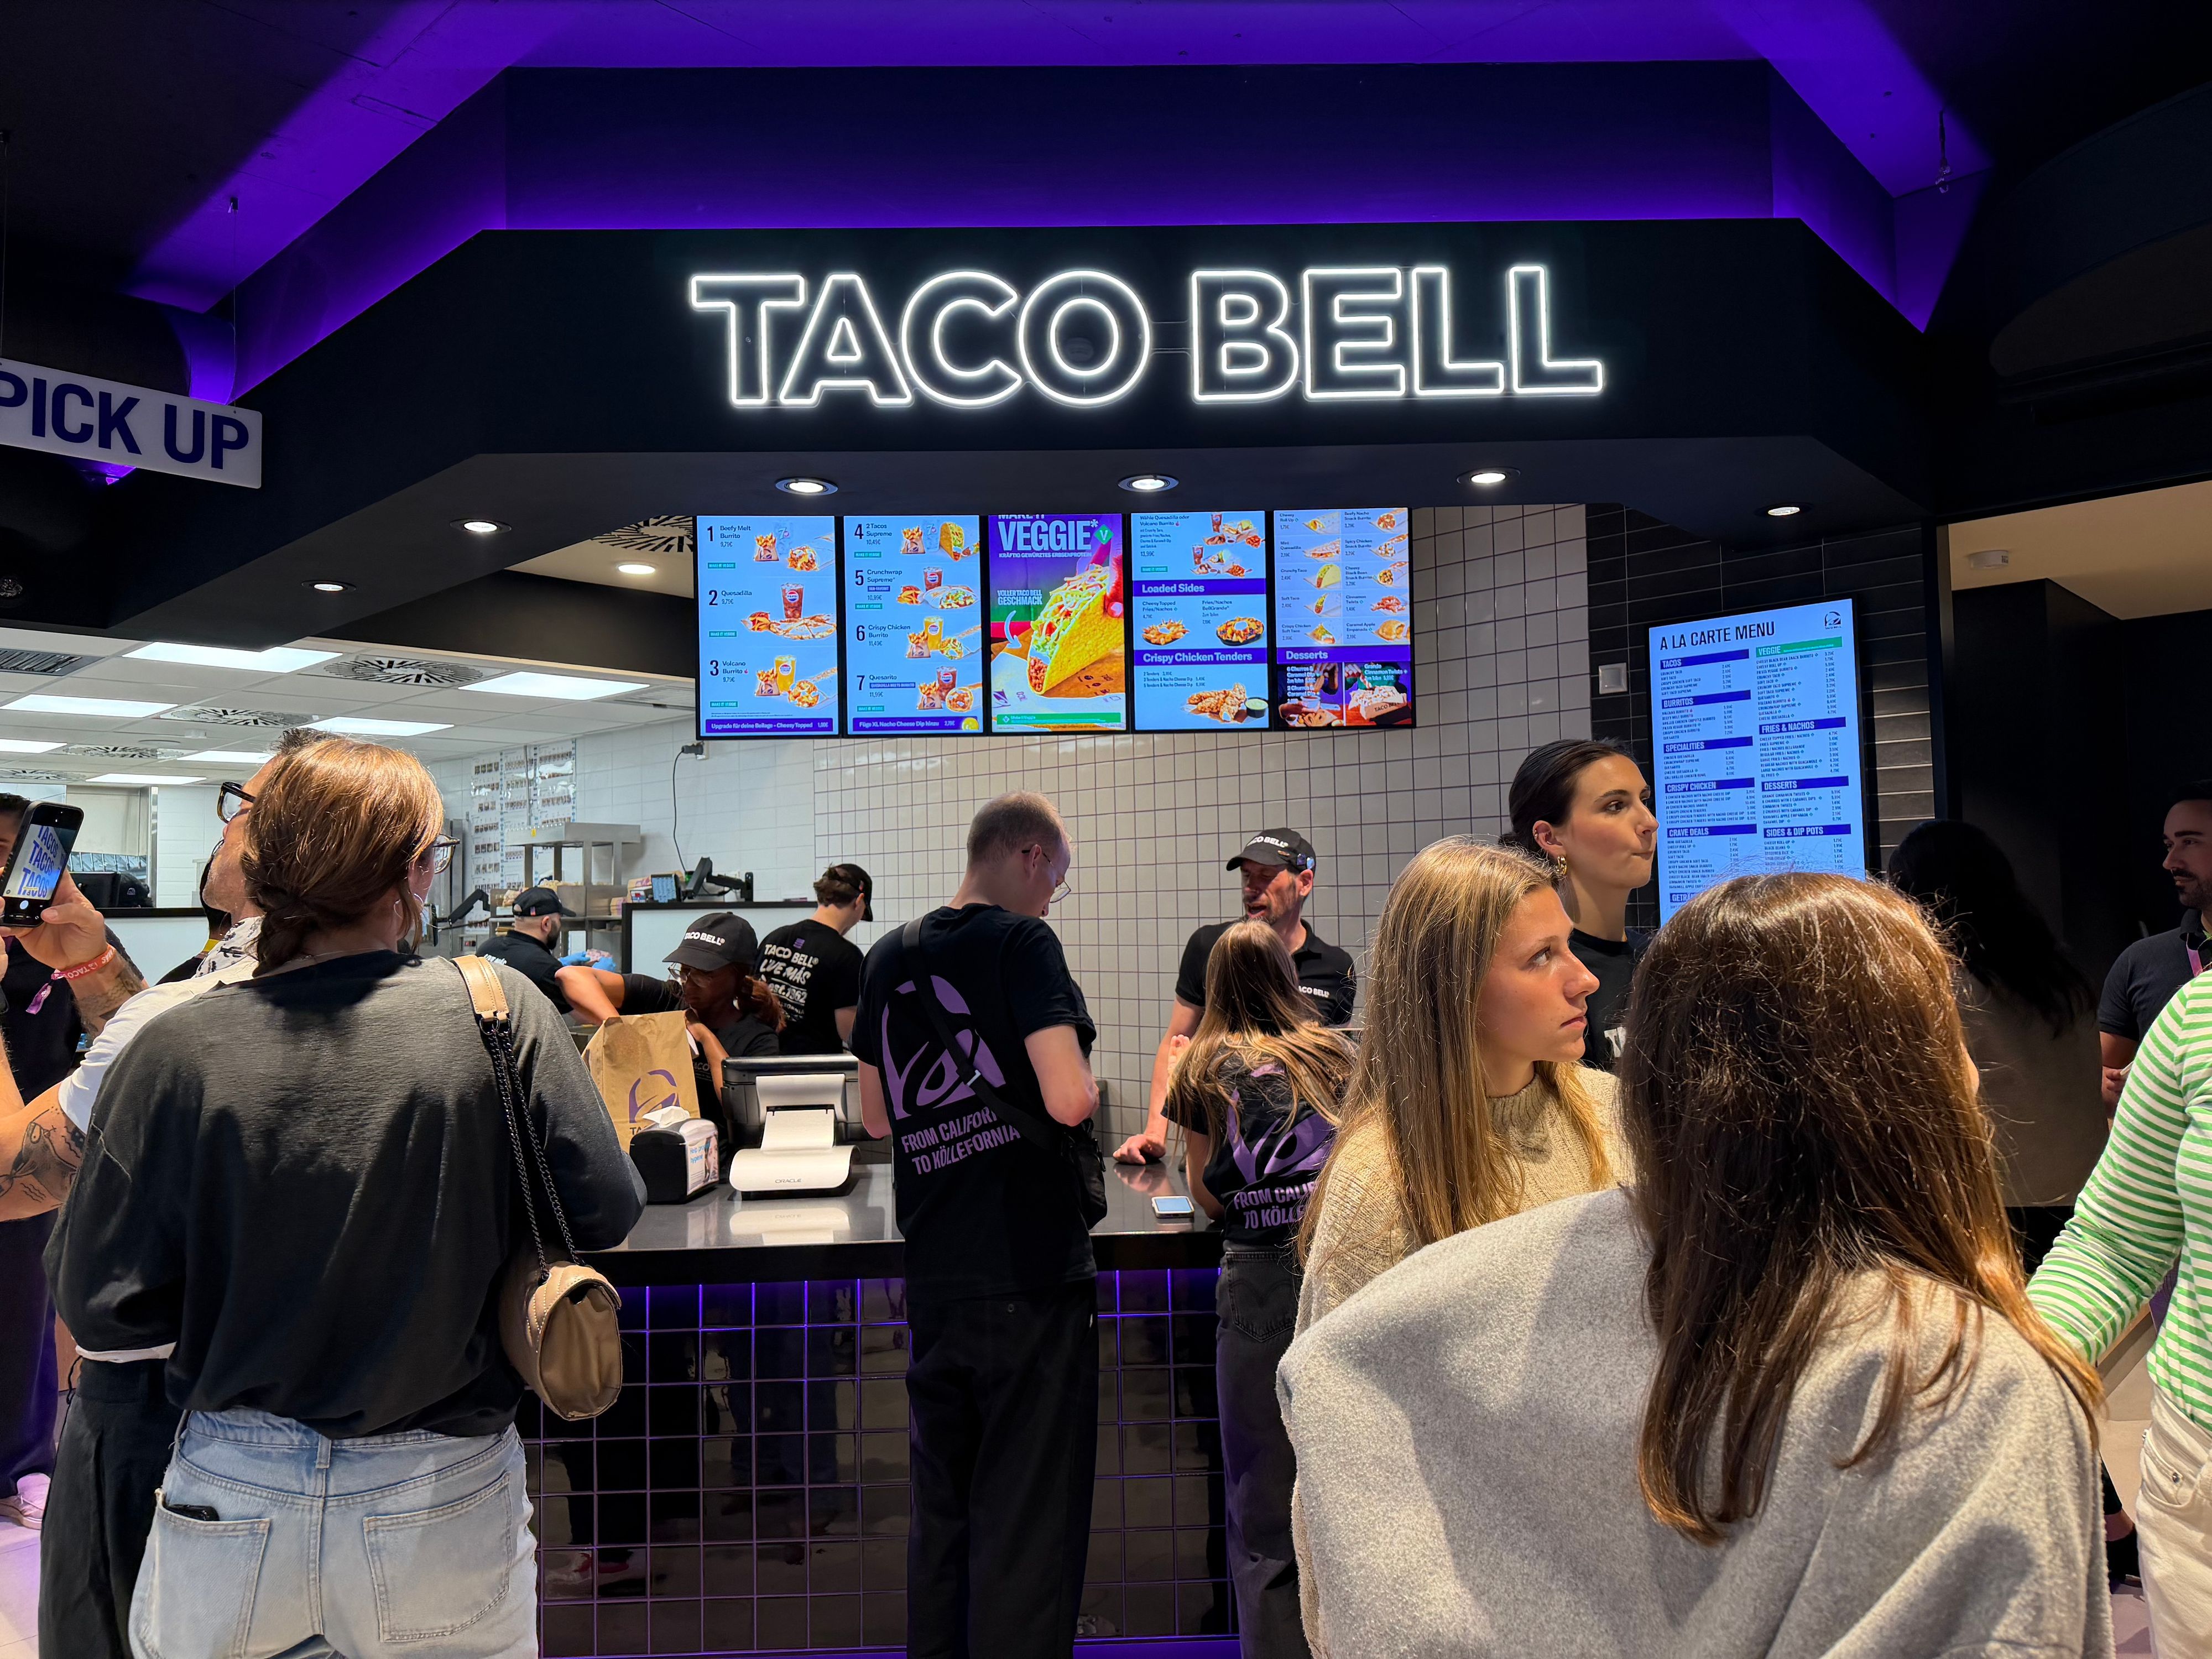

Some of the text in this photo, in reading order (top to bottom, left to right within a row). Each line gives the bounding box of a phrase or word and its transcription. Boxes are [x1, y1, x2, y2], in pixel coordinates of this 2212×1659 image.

[691, 265, 1605, 406] TACO BELL
[164, 404, 249, 469] UP
[707, 526, 713, 541] 1
[854, 524, 864, 539] 4
[855, 570, 864, 586] 5
[1142, 583, 1205, 593] Loaded Sides
[709, 590, 718, 606] 2
[998, 596, 1043, 606] GESCHMACK
[857, 625, 865, 641] 6
[1660, 621, 1775, 650] A LA CARTE MENU
[1143, 651, 1253, 664] Crispy Chicken Tenders
[1286, 650, 1328, 660] Desserts
[1758, 645, 1781, 656] VEGGIE
[710, 660, 719, 676] 3
[1662, 659, 1682, 668] TACOS
[857, 675, 865, 690] 7
[1663, 697, 1694, 708] BURRITOS
[1761, 724, 1780, 734] FRIES
[1788, 721, 1815, 731] NACHOS
[1665, 742, 1705, 753] SPECIALITIES
[1667, 781, 1717, 792] CRISPY CHICKEN
[1764, 780, 1797, 791] DESSERTS
[1669, 827, 1709, 837] CRAVE DEALS
[1766, 828, 1786, 837] SIDES
[1793, 827, 1805, 836] DIP
[1806, 826, 1824, 835] POTS
[29, 839, 54, 876] TACOS
[18, 867, 50, 898] TACOS
[764, 944, 792, 959] TACO
[782, 966, 811, 985] MÁS
[901, 1127, 940, 1154] FROM
[912, 1125, 1021, 1175] TO KÖLLEFORNIA
[1234, 1188, 1272, 1209] FROM
[1243, 1209, 1259, 1229] TO
